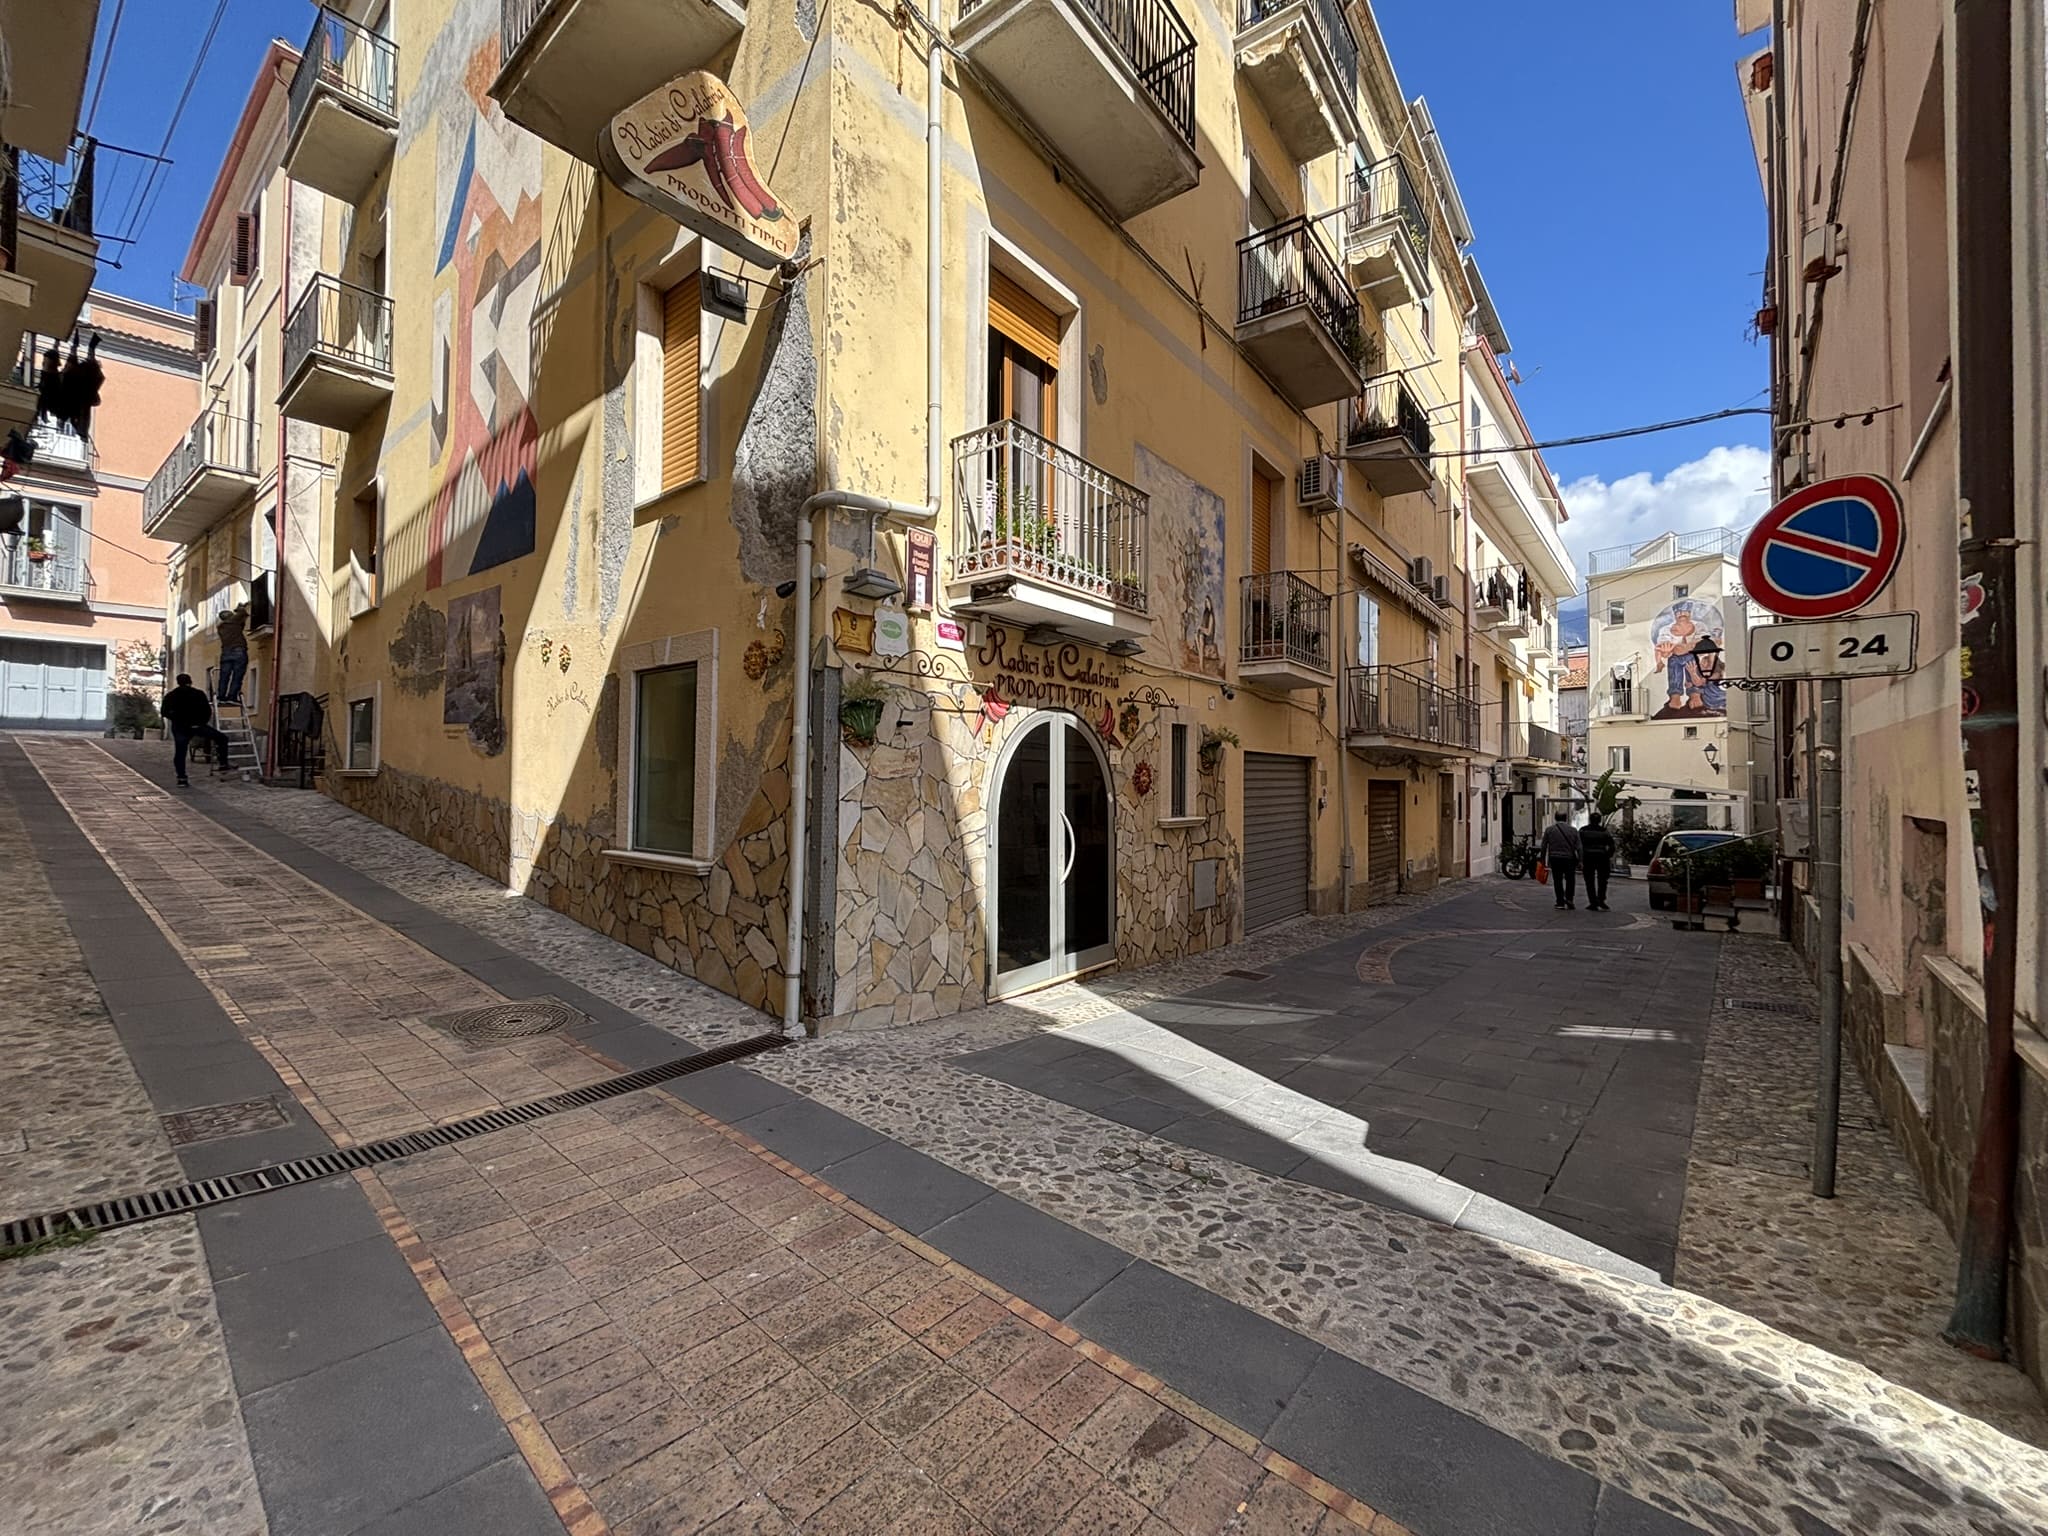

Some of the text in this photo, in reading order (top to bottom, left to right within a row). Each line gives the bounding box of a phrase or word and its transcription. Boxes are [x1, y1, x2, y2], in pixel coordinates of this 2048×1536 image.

[618, 84, 725, 159] Radici di Calabria
[667, 174, 787, 253] PRODOTTI TIPICI
[978, 625, 1040, 675] Radici
[1043, 649, 1055, 679] di
[1059, 644, 1119, 689] Calabria
[1770, 641, 1793, 661] 0
[1838, 634, 1888, 658] 24
[996, 673, 1067, 705] PRODOTTI
